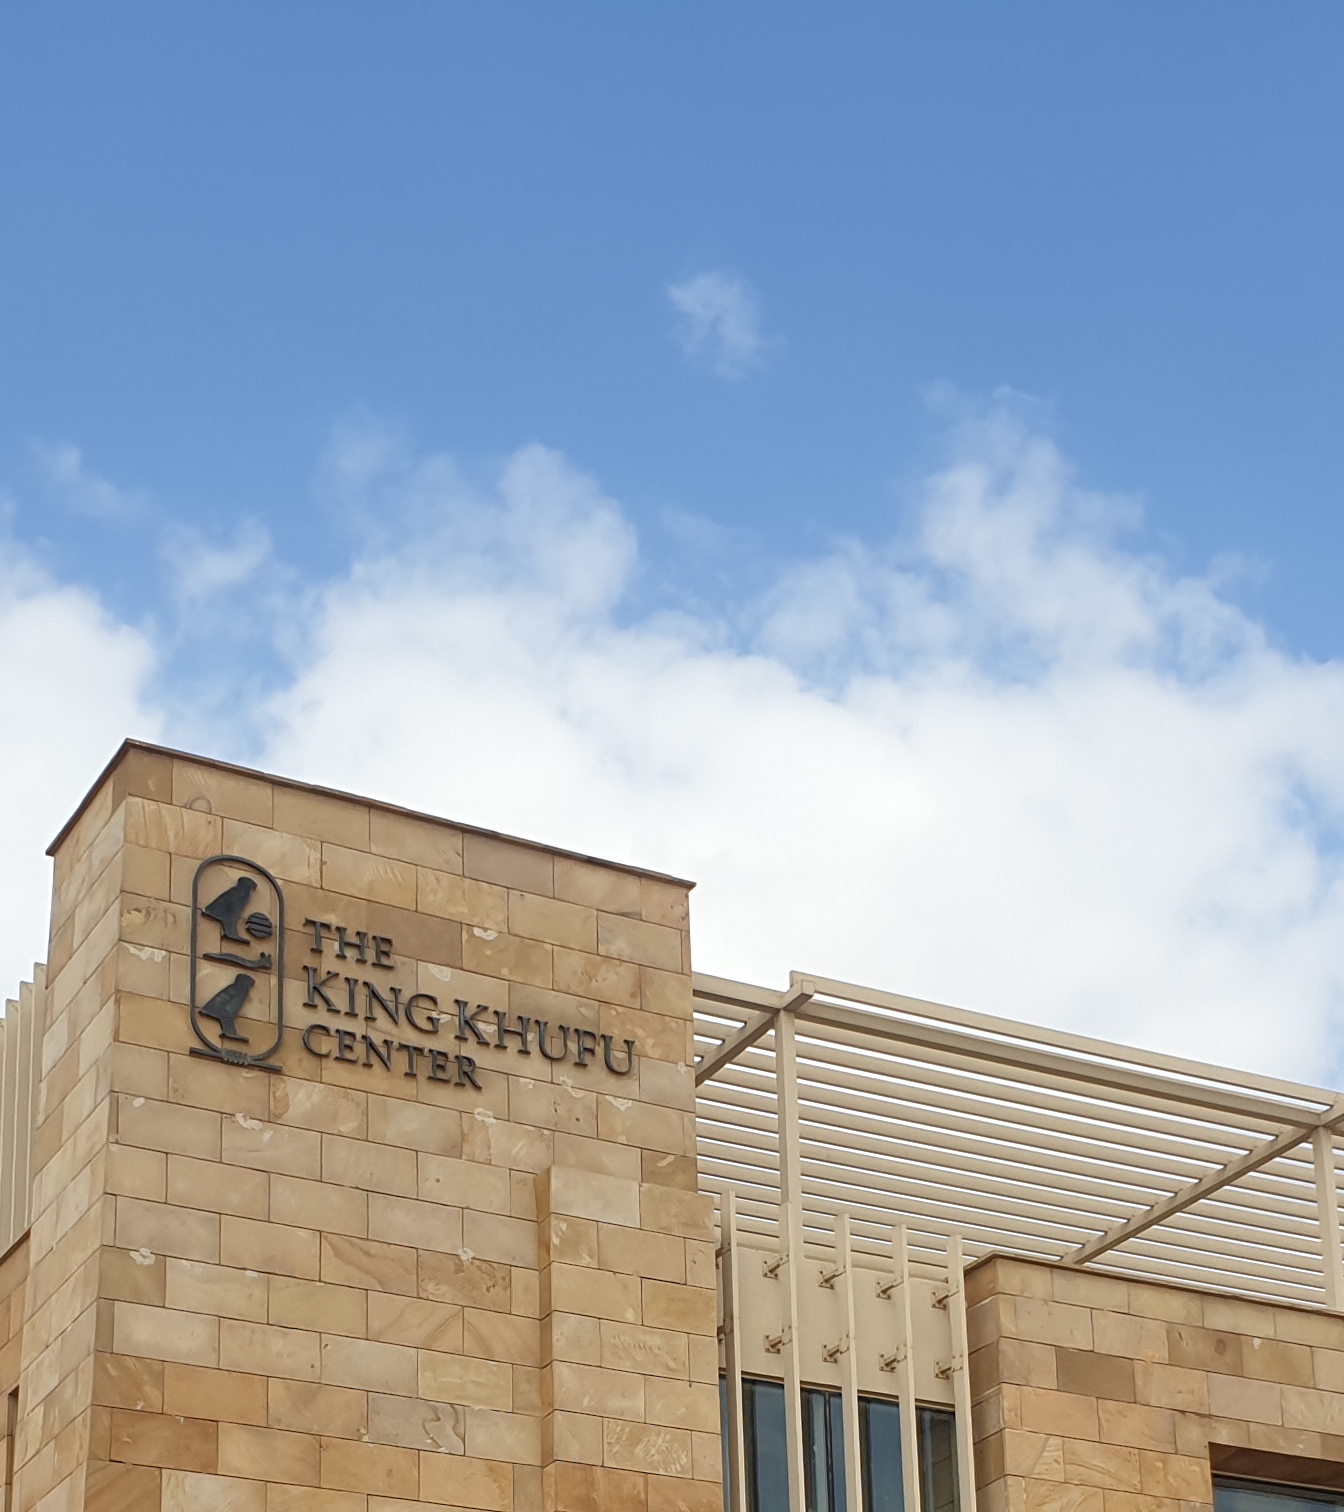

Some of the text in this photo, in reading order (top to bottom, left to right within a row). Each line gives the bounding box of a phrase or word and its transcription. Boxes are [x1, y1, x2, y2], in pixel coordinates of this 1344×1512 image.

[302, 917, 395, 969] THE
[302, 965, 636, 1075] KING KHUFU
[302, 1023, 483, 1090] CENTER
